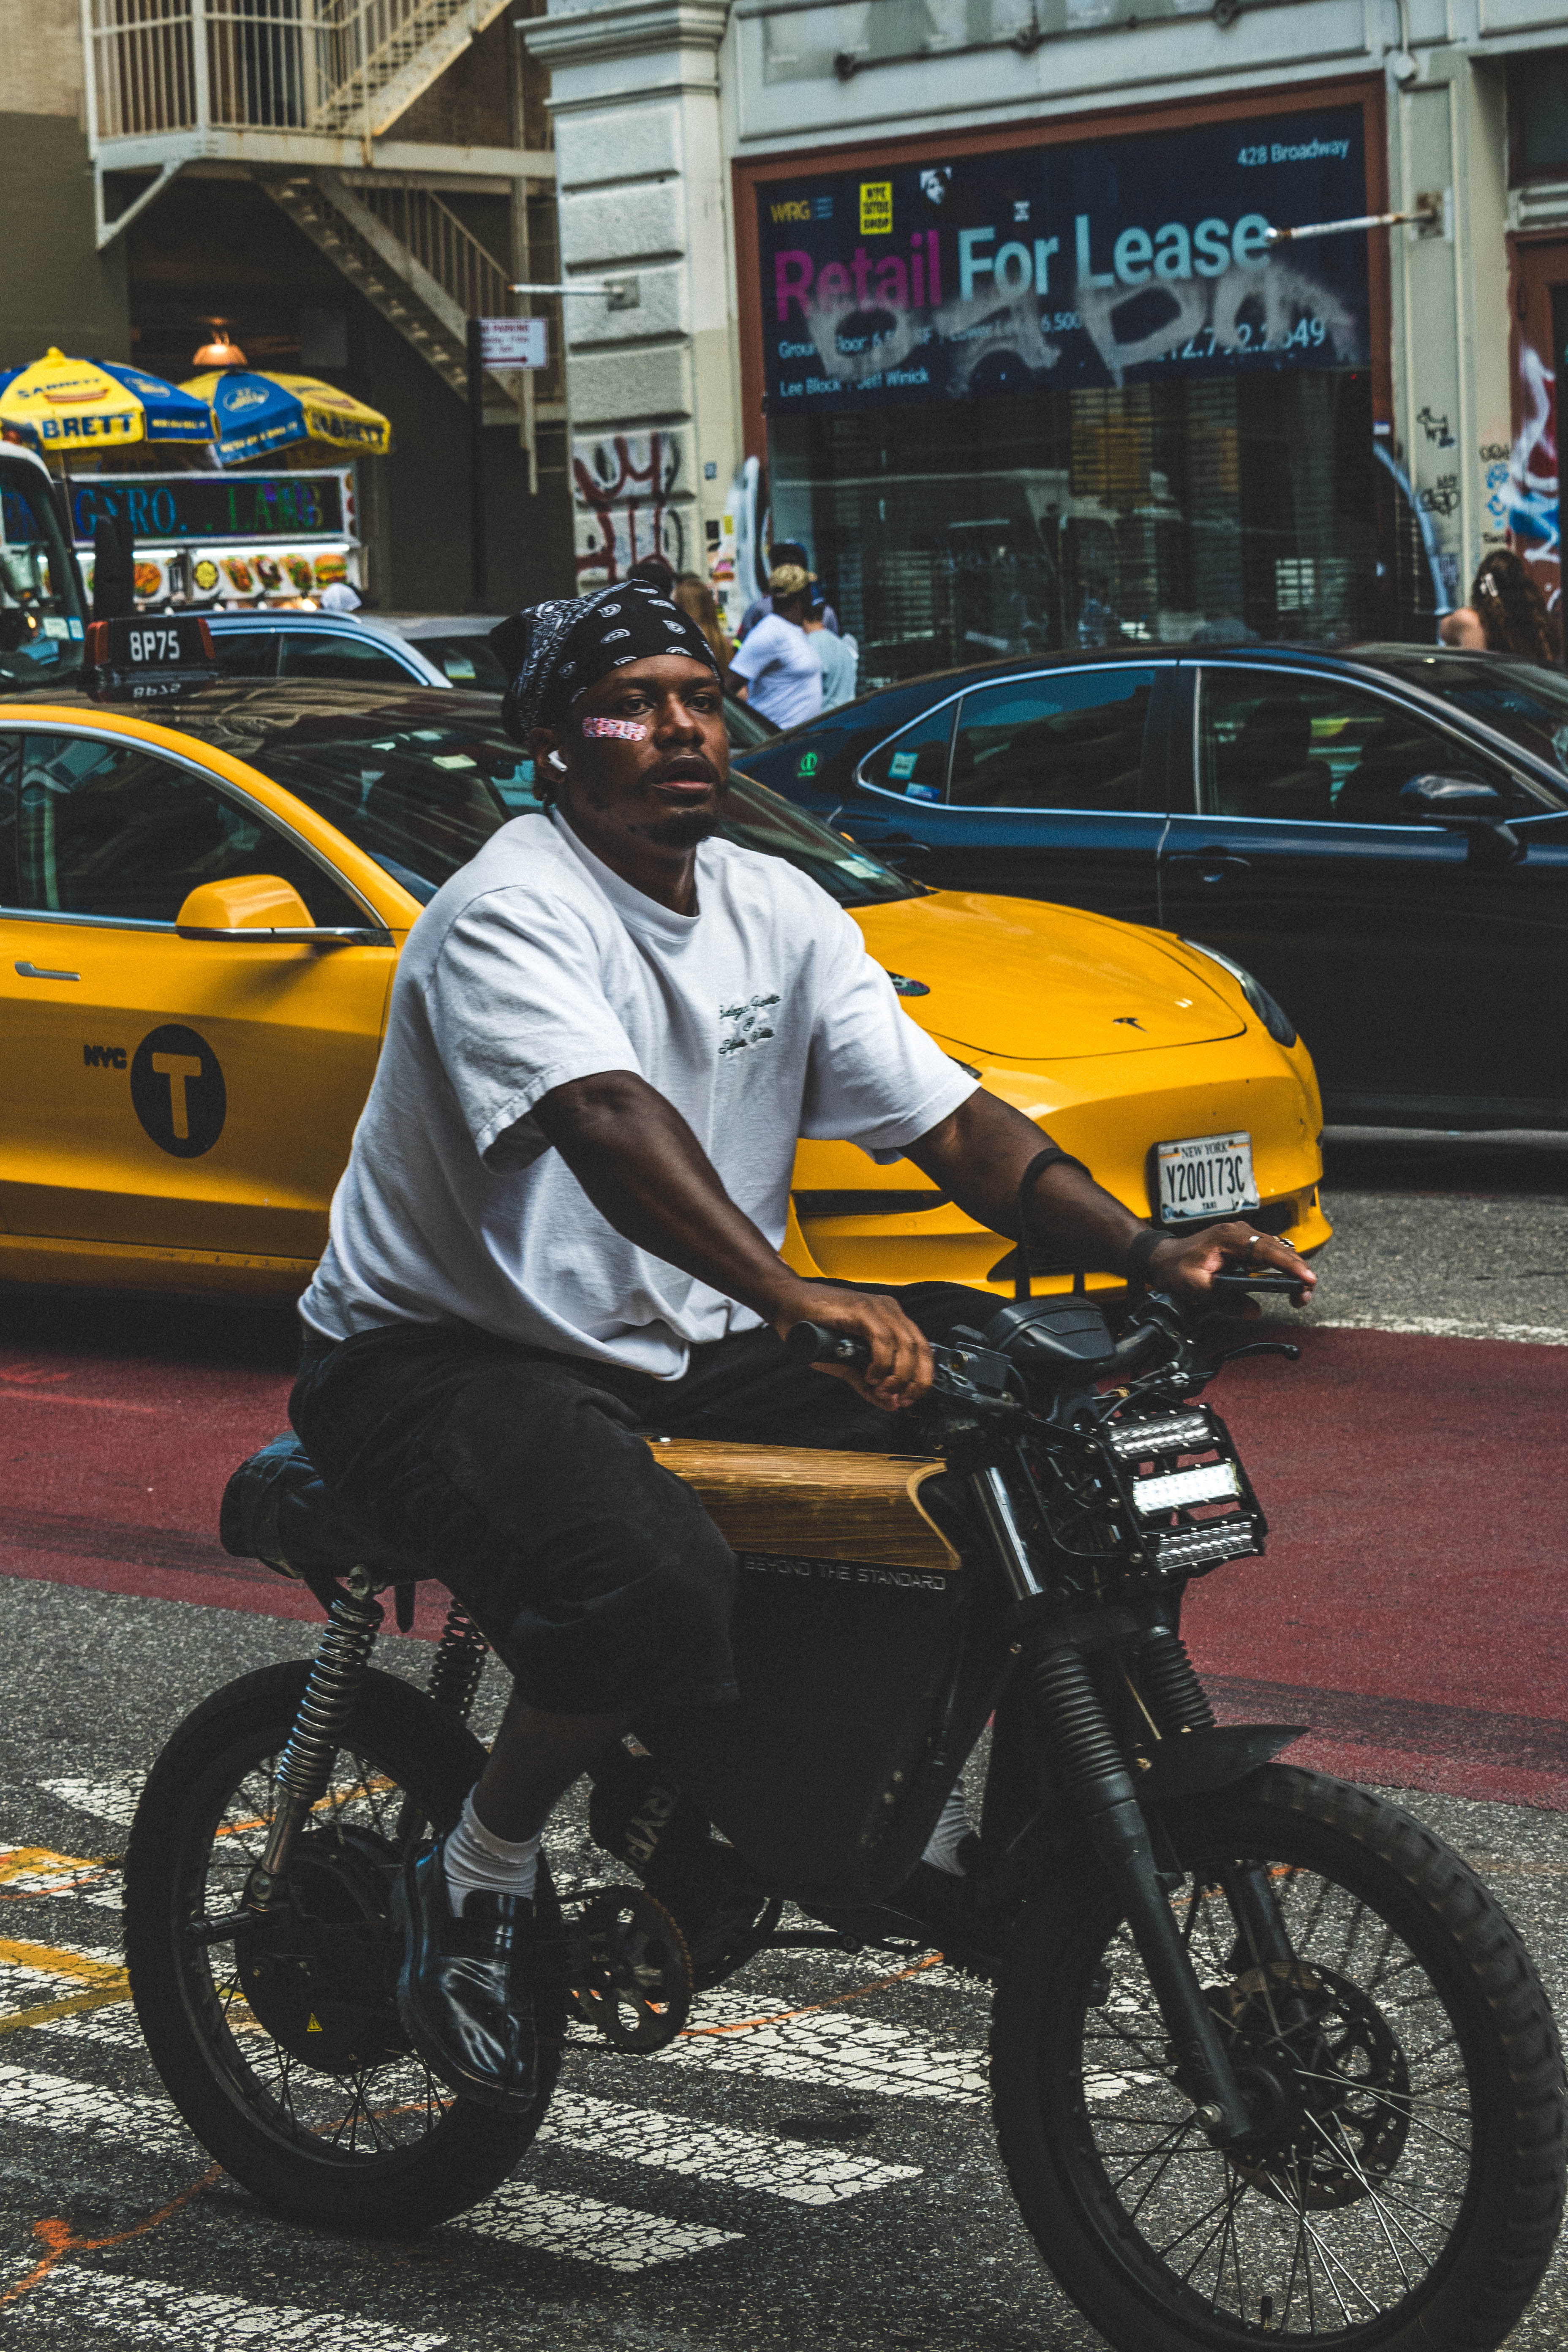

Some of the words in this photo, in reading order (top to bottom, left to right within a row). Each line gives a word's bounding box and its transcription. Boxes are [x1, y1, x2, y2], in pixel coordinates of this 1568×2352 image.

[1270, 137, 1350, 164] Broadway
[775, 229, 942, 322] Retail
[958, 226, 1059, 302] For
[1075, 212, 1270, 289] Lease
[778, 340, 819, 359] Grou
[779, 380, 803, 397] Lee
[42, 413, 133, 439] BRETT
[129, 629, 181, 662] 8P75
[83, 1044, 127, 1070] NYC
[152, 1052, 202, 1139] T
[1181, 1144, 1203, 1158] NEW
[1205, 1141, 1228, 1154] YORK
[1166, 1155, 1245, 1203] Y200173C
[746, 1556, 810, 1576] BEYOND
[817, 1564, 850, 1580] THE
[857, 1568, 946, 1590] STANDARD
